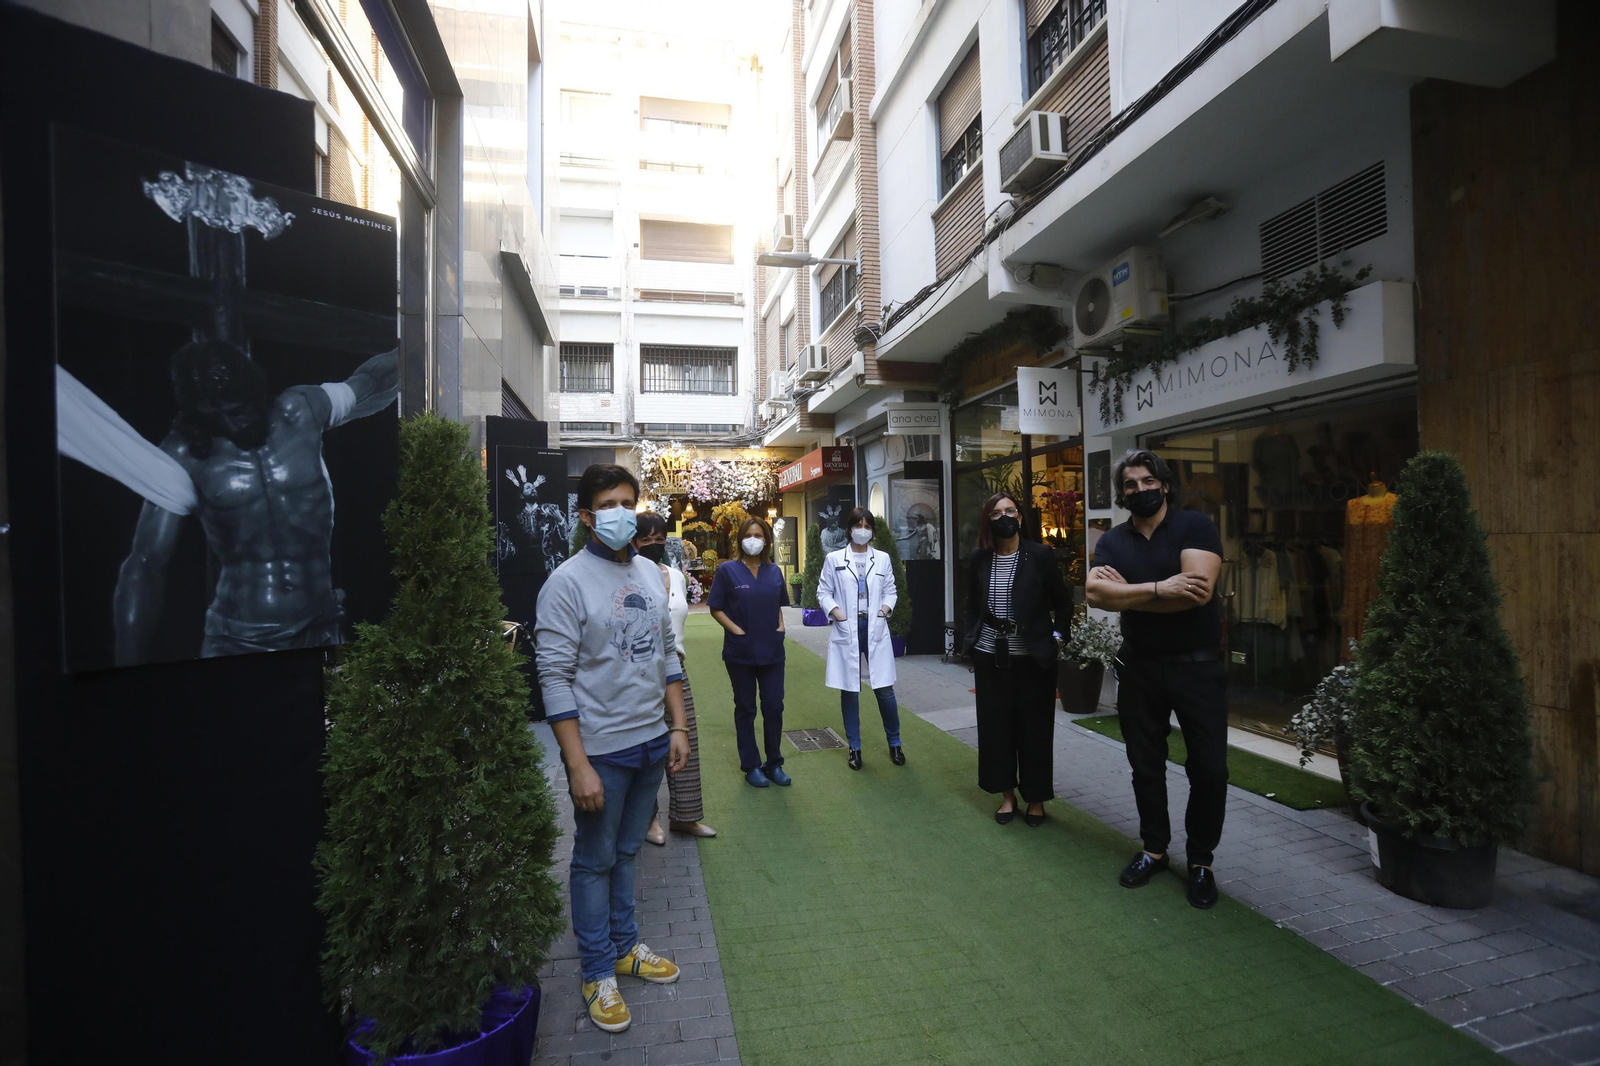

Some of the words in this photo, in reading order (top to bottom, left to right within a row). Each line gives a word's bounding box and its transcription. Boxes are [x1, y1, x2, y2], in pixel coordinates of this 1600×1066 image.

[311, 206, 341, 220] JESÚS
[344, 215, 392, 232] MARTÍNEZ
[1157, 341, 1277, 396] MIMONA
[914, 413, 938, 423] chez
[1023, 408, 1074, 418] MIMONA
